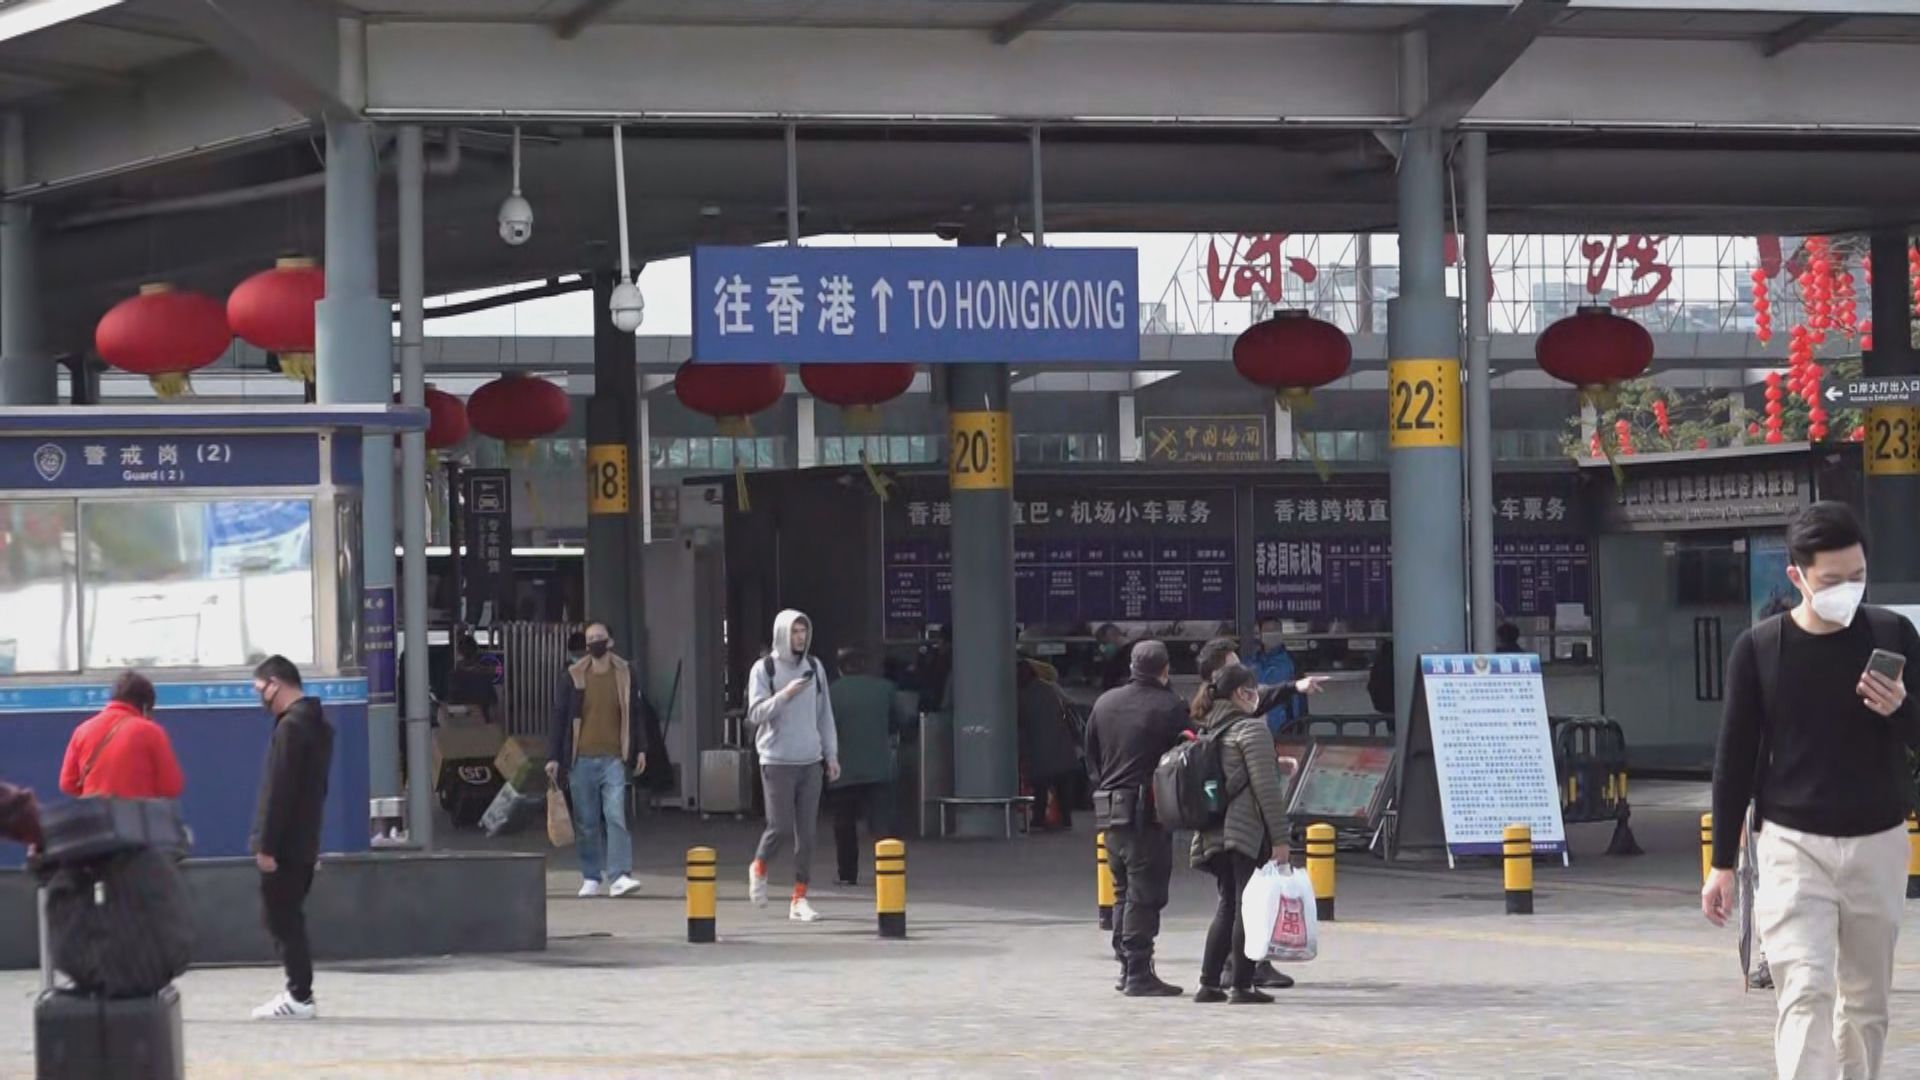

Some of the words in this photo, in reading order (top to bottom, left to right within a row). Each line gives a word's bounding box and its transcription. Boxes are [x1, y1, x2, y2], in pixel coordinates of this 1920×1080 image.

[714, 273, 856, 336] 往香港
[908, 279, 948, 330] TO
[955, 279, 1126, 330] HONGKONG
[1395, 379, 1436, 430] 22
[1848, 380, 1920, 394] 口岸大厅出入口
[955, 429, 990, 474] 20
[1875, 418, 1910, 460] 23
[592, 461, 619, 499] 18
[1255, 541, 1323, 577] 香港国际机场
